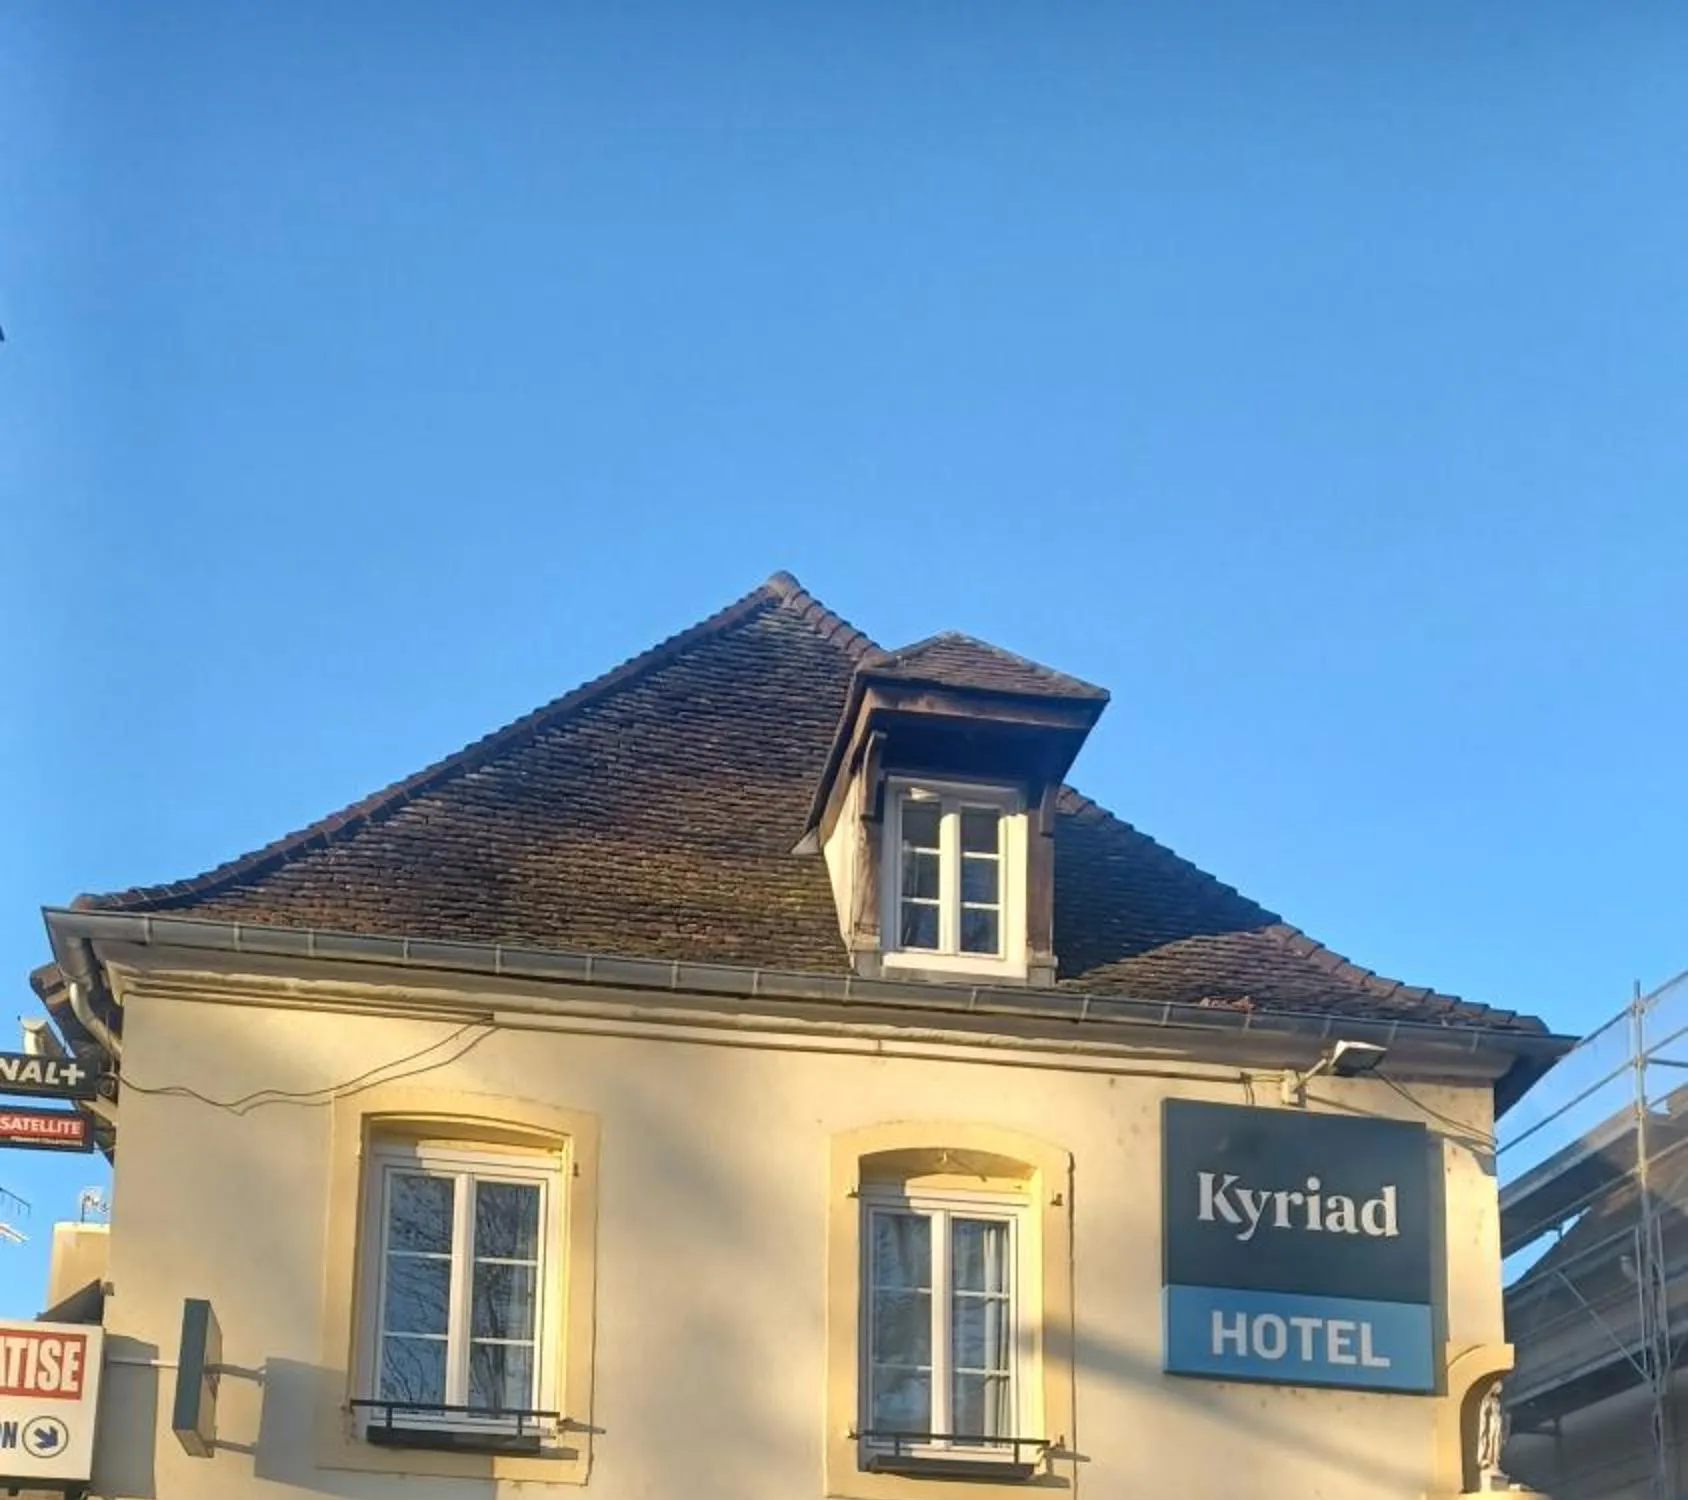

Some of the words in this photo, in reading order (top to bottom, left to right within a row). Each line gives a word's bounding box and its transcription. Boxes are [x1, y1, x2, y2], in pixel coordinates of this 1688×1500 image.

[0, 1115, 81, 1135] SATELLITE
[1197, 1171, 1400, 1241] Kyriad
[0, 1335, 81, 1393] TISE
[1211, 1310, 1391, 1368] HOTEL
